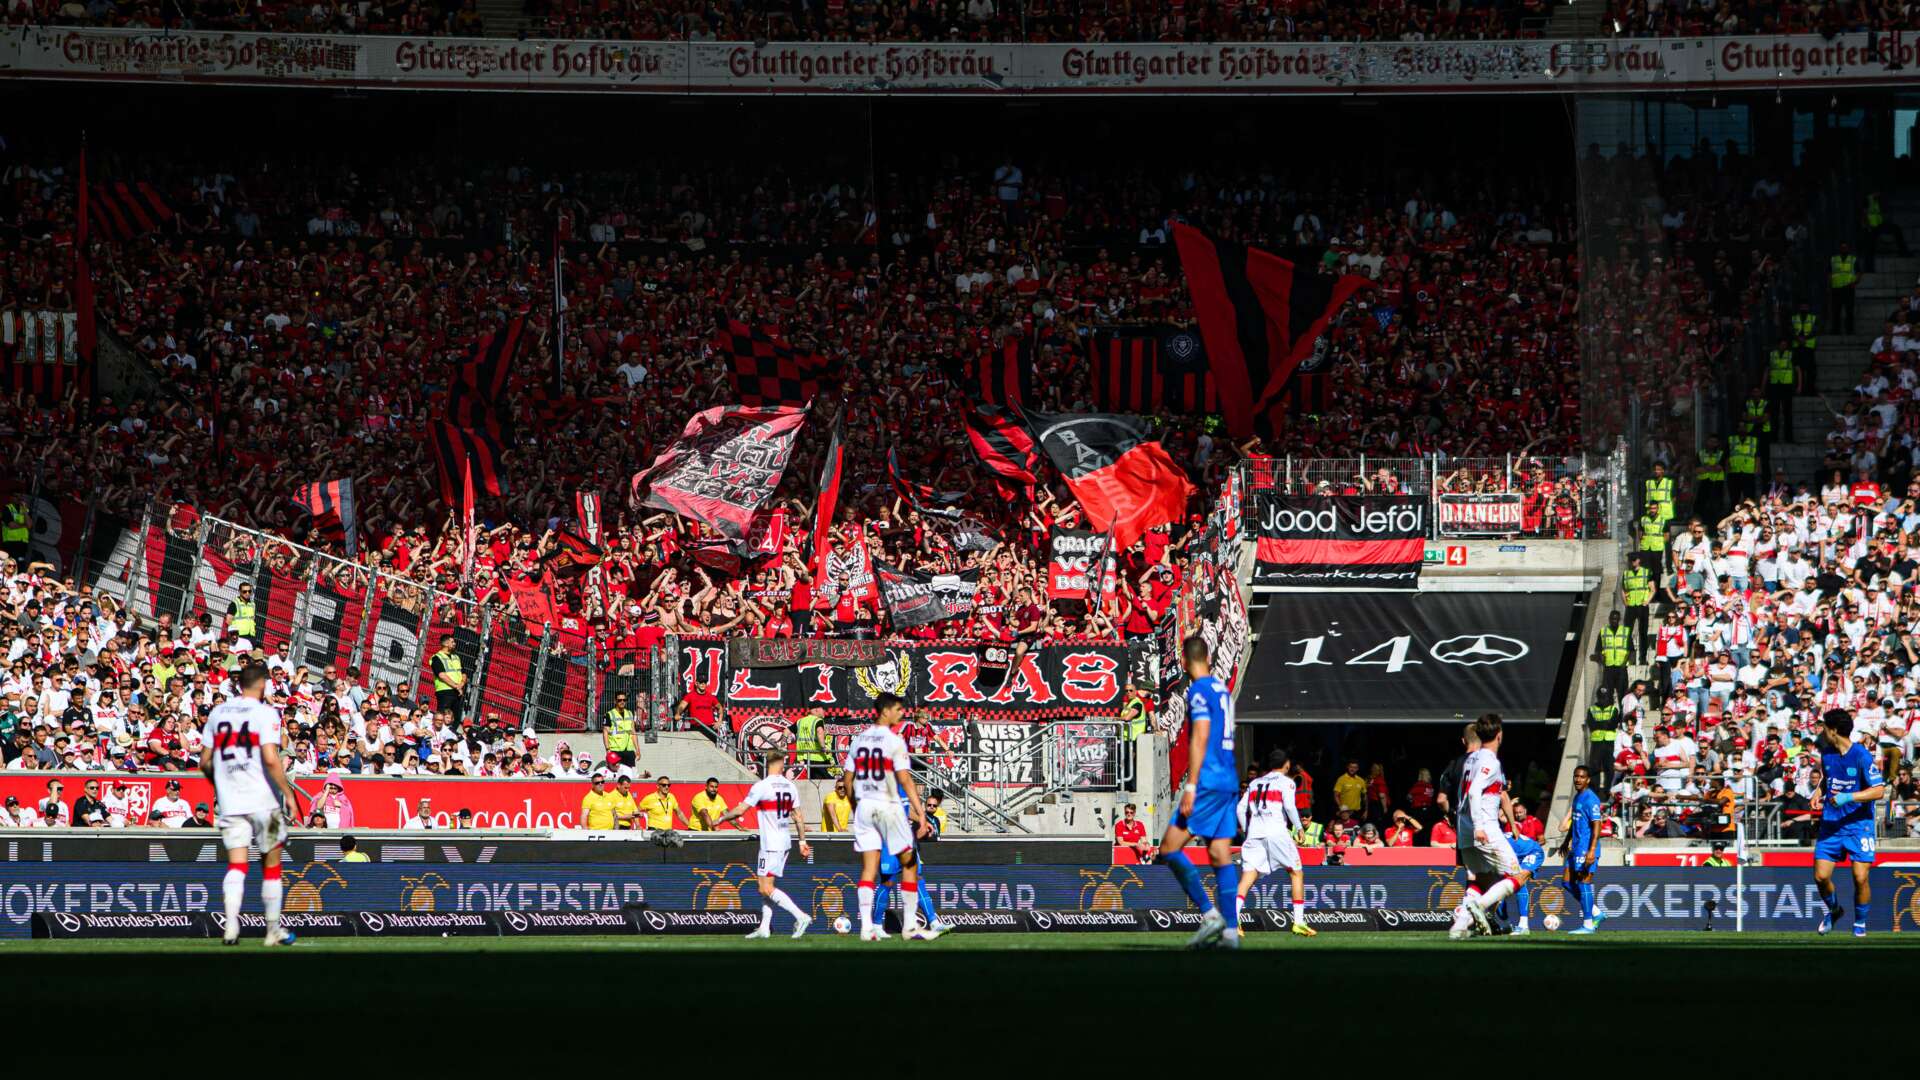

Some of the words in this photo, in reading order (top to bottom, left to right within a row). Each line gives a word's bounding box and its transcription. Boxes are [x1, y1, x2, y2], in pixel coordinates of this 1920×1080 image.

[728, 45, 877, 83] Stuttgarter
[884, 46, 995, 80] Hofbräu
[1062, 46, 1211, 83] Stuttgarter
[1218, 46, 1328, 80] Hofbräu
[1721, 41, 1871, 75] Stuttgarter
[1261, 503, 1337, 533] Jood
[1350, 504, 1423, 533] Jeföl
[1442, 502, 1520, 523] DJANGOS
[1449, 546, 1463, 565] 4
[217, 720, 254, 761] 24
[976, 723, 1032, 740] WEST
[0, 883, 209, 925] OKERSTAR
[456, 883, 645, 911] JOKERSTAR
[1590, 883, 1829, 919] OKERSTAR
[84, 912, 193, 928] Mercedes-Benz
[238, 911, 343, 928] Merdes-Benz
[382, 911, 487, 928] Mercedes-Benz
[523, 911, 627, 927] Mercedes-Benz
[668, 911, 761, 926] Mercedes-Benz
[1050, 911, 1138, 926] Mercedes-Benz
[1397, 909, 1458, 923] Mercedes-
